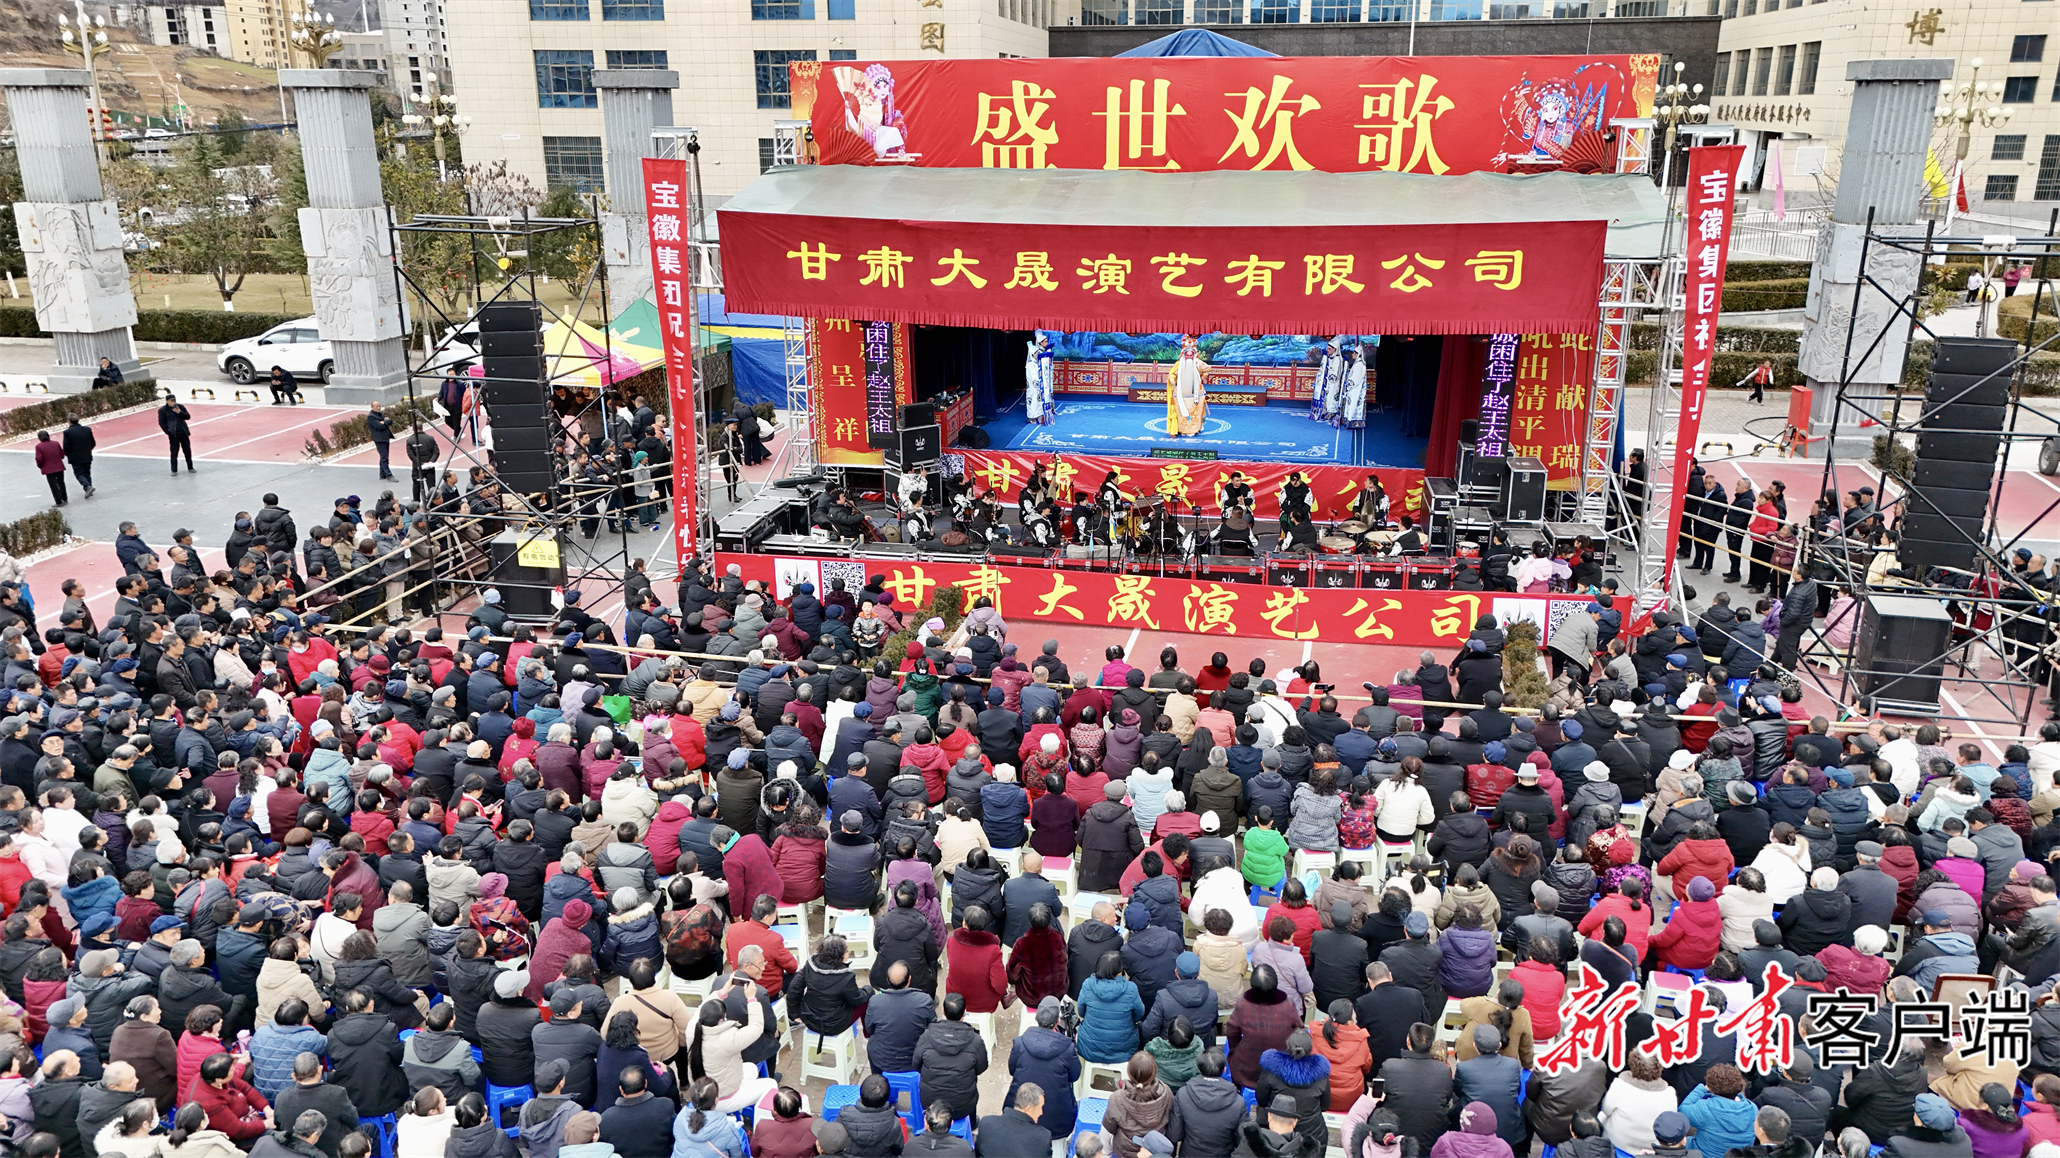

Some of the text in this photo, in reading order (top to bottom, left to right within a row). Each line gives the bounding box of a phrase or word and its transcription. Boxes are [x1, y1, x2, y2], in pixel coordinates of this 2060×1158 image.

[1906, 8, 1945, 45] 博
[971, 74, 1454, 174] 盛世欢歌
[787, 241, 1524, 298] 甘肃大晟演艺有限公司
[884, 563, 1484, 644] 甘肃大晟演艺公司
